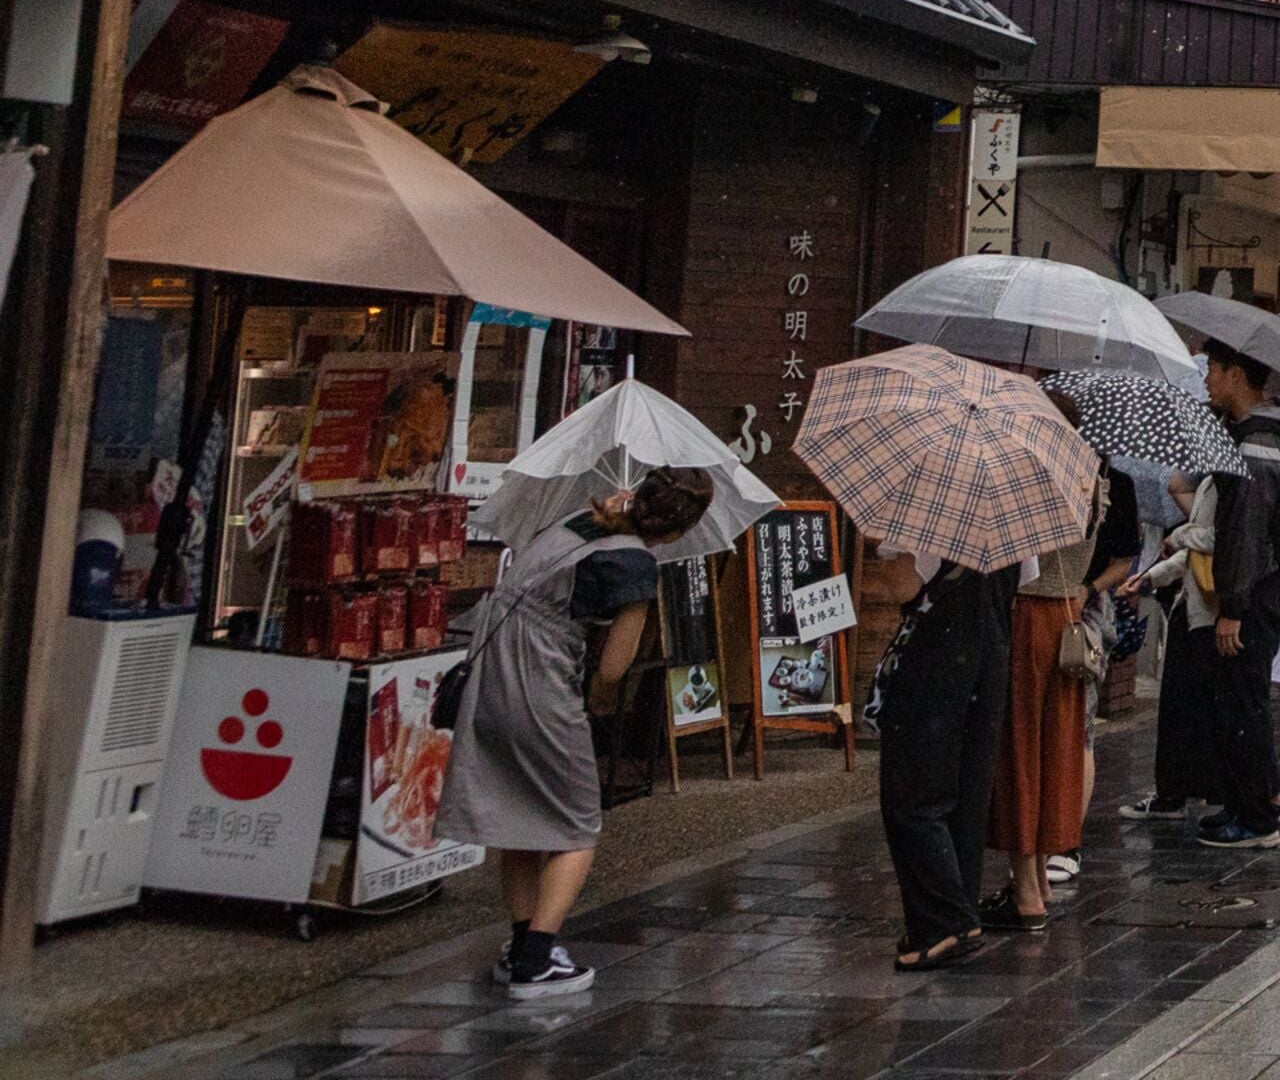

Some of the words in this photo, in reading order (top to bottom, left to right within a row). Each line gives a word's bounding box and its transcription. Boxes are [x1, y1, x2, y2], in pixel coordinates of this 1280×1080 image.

[987, 134, 1002, 176] ふくや
[971, 225, 1010, 234] Restaurant
[779, 229, 815, 422] 味の明太子
[796, 517, 809, 573] ふくやの
[812, 516, 826, 560] 店内で
[758, 523, 776, 633] 召し上がれます。
[777, 524, 794, 615] 明太茶漬け
